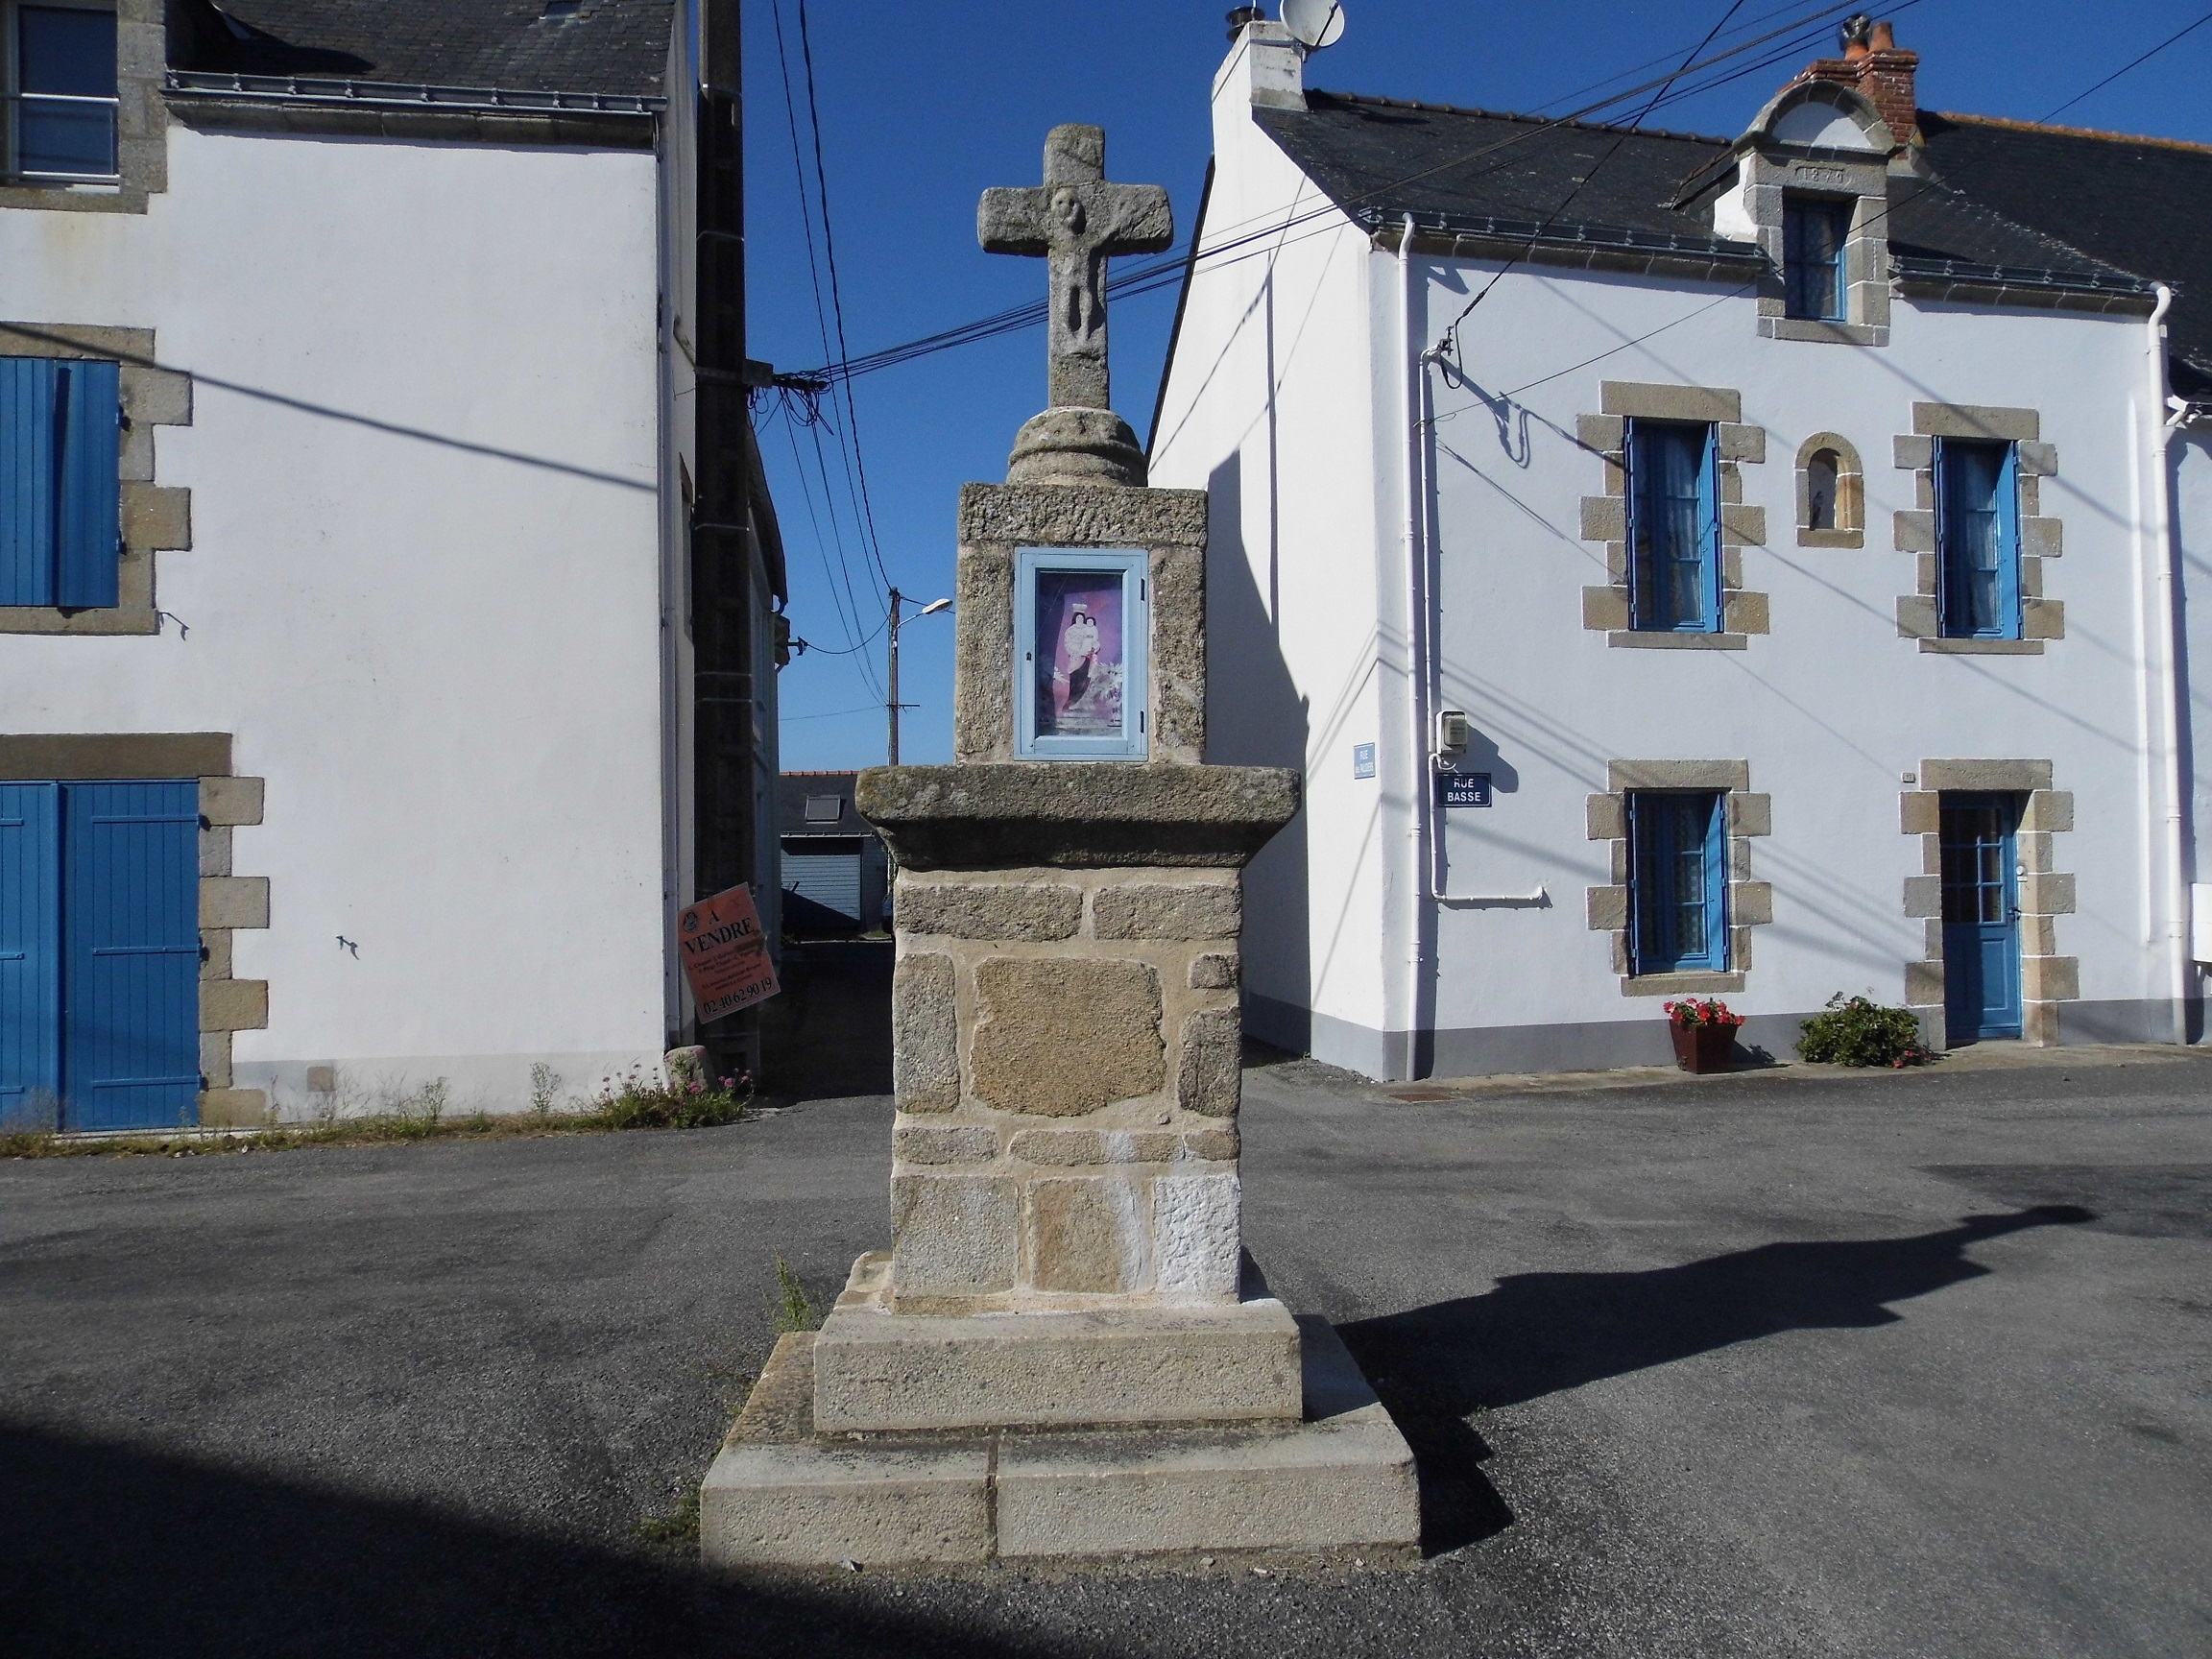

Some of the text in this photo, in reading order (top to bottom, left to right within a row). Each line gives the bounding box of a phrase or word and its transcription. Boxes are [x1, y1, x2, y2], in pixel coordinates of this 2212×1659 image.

[1454, 778, 1474, 788] RUE
[1447, 792, 1481, 801] BASSE
[709, 910, 720, 925] A
[685, 917, 754, 954] VENDRE
[703, 977, 772, 1015] 02 40 62 90 19
